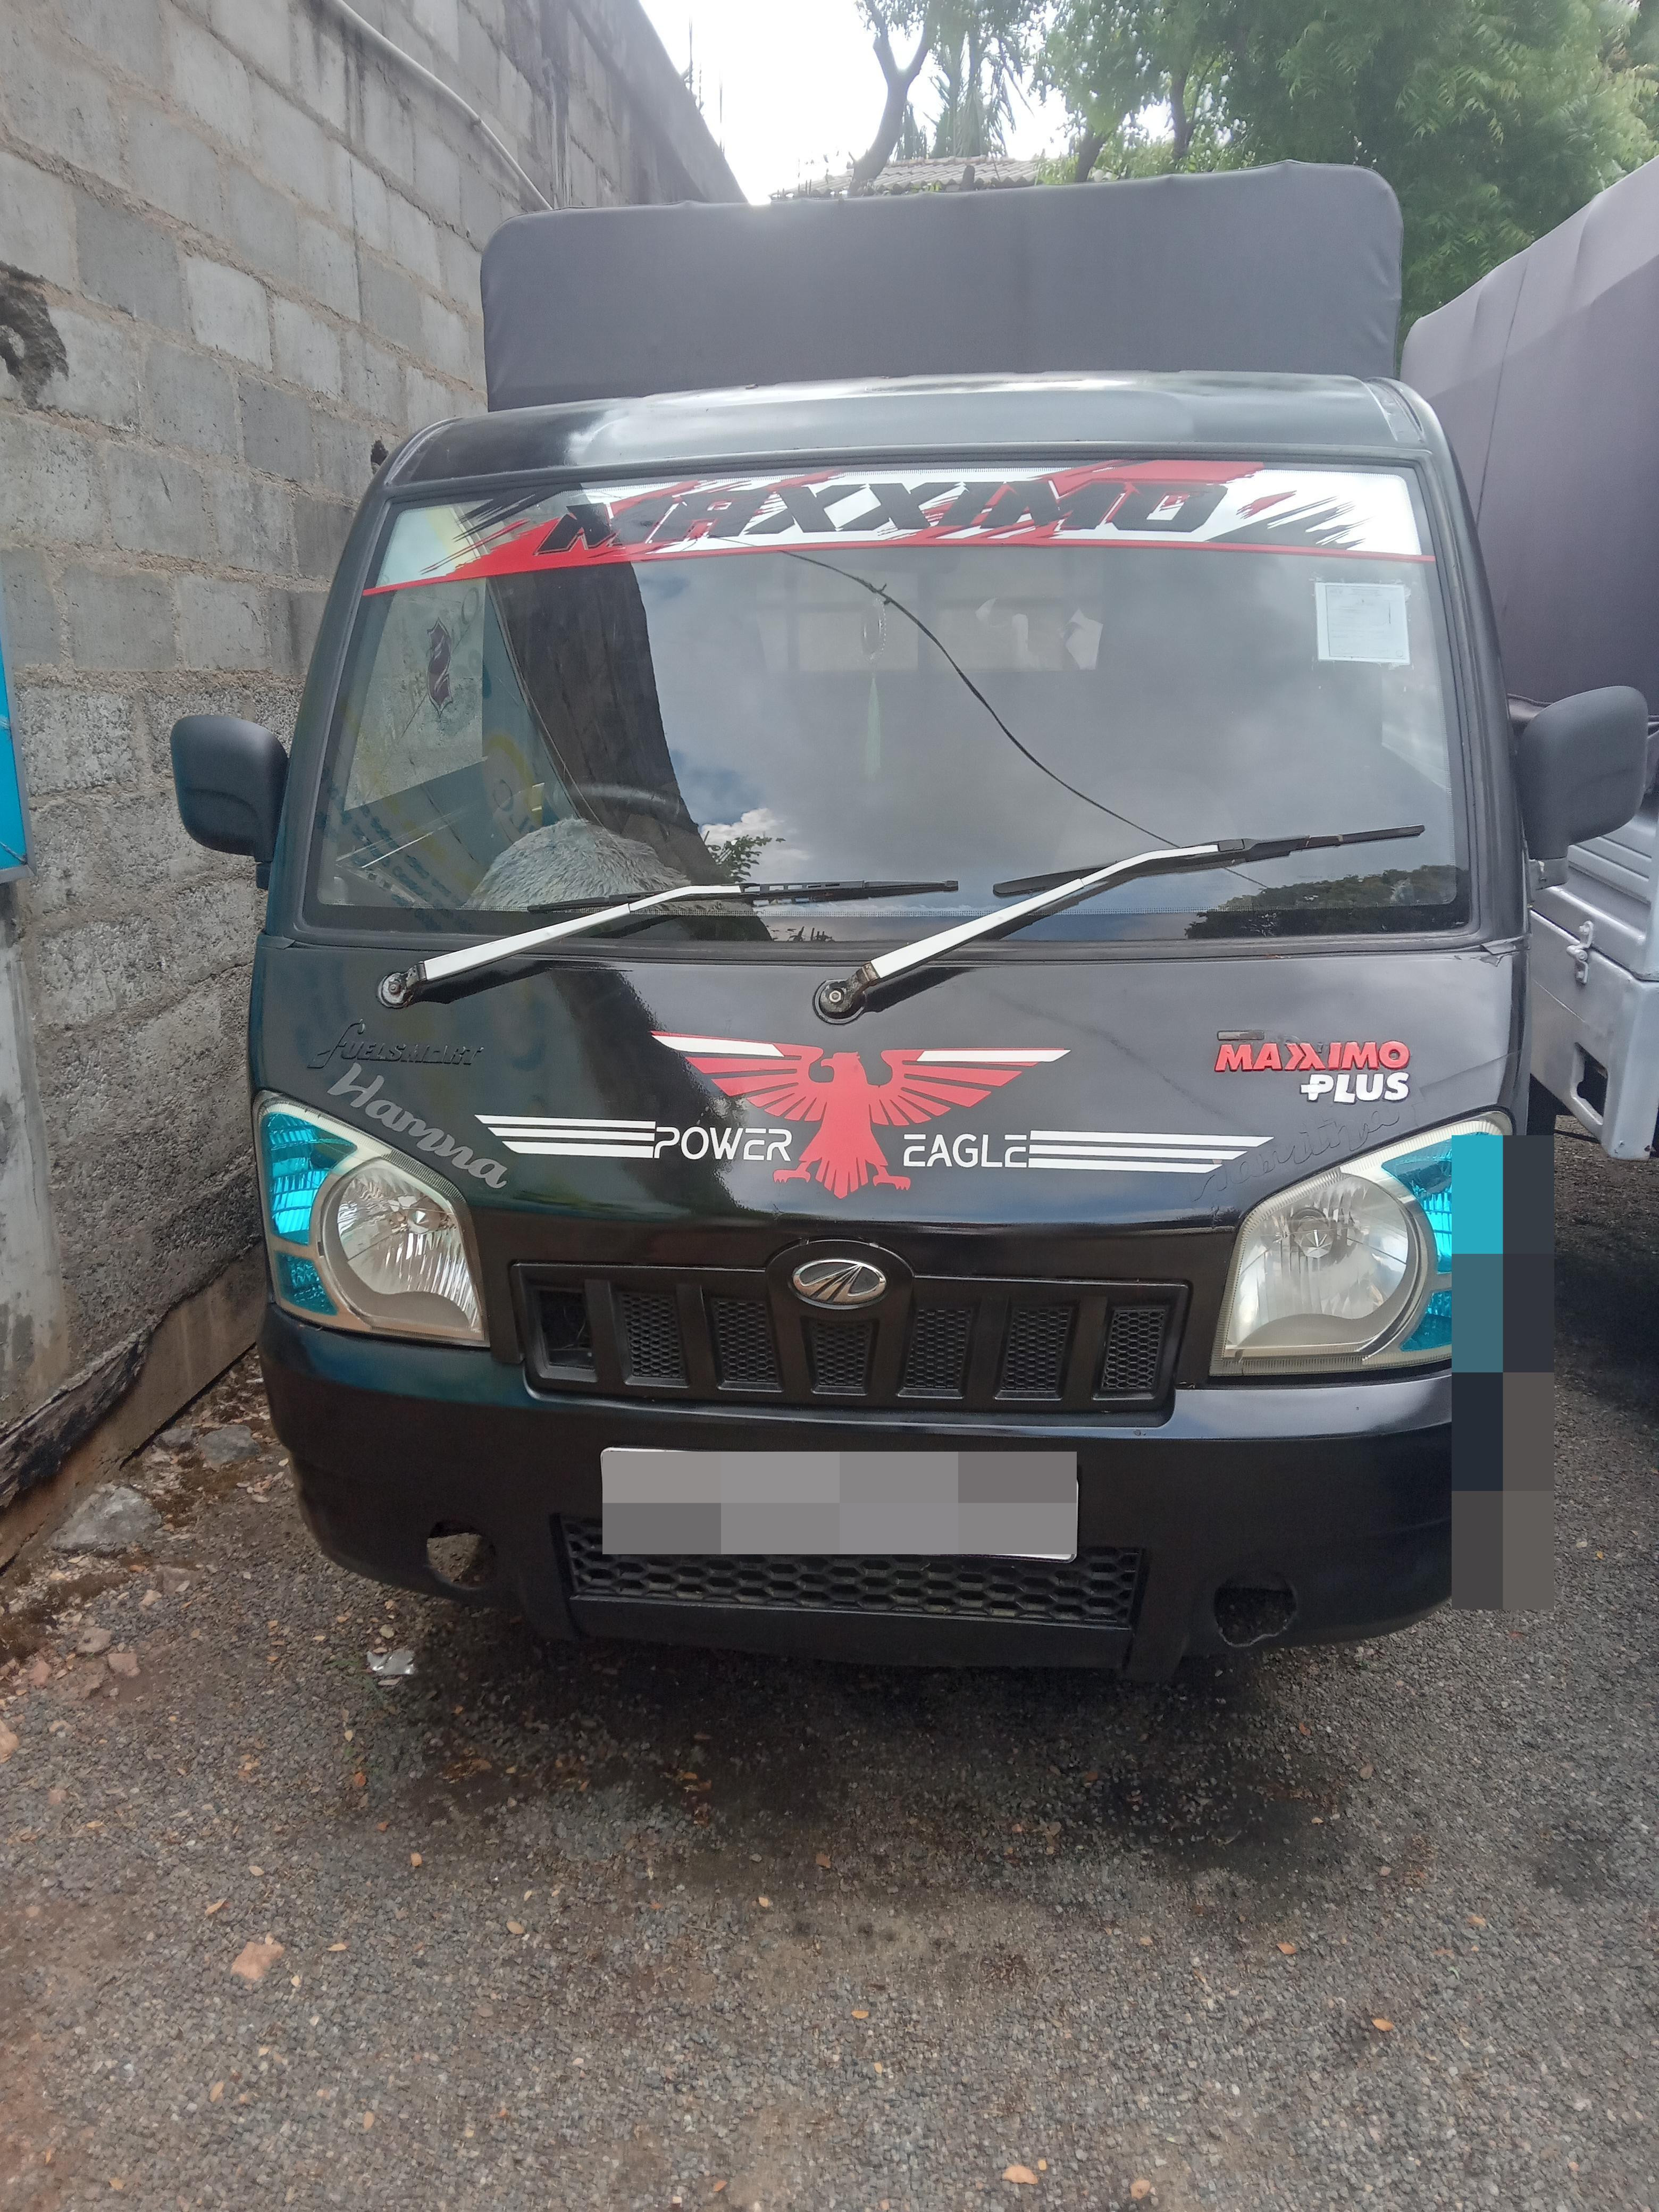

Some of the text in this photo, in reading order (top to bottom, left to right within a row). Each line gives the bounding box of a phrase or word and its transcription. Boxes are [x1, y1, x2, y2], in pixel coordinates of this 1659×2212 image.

[533, 479, 1228, 556] MAXXIMO
[1214, 1040, 1410, 1072] MAXXIMO
[1300, 1071, 1410, 1104] PLUS
[326, 1063, 508, 1189] Hamna
[655, 1126, 1028, 1168] POWER EAGLE
